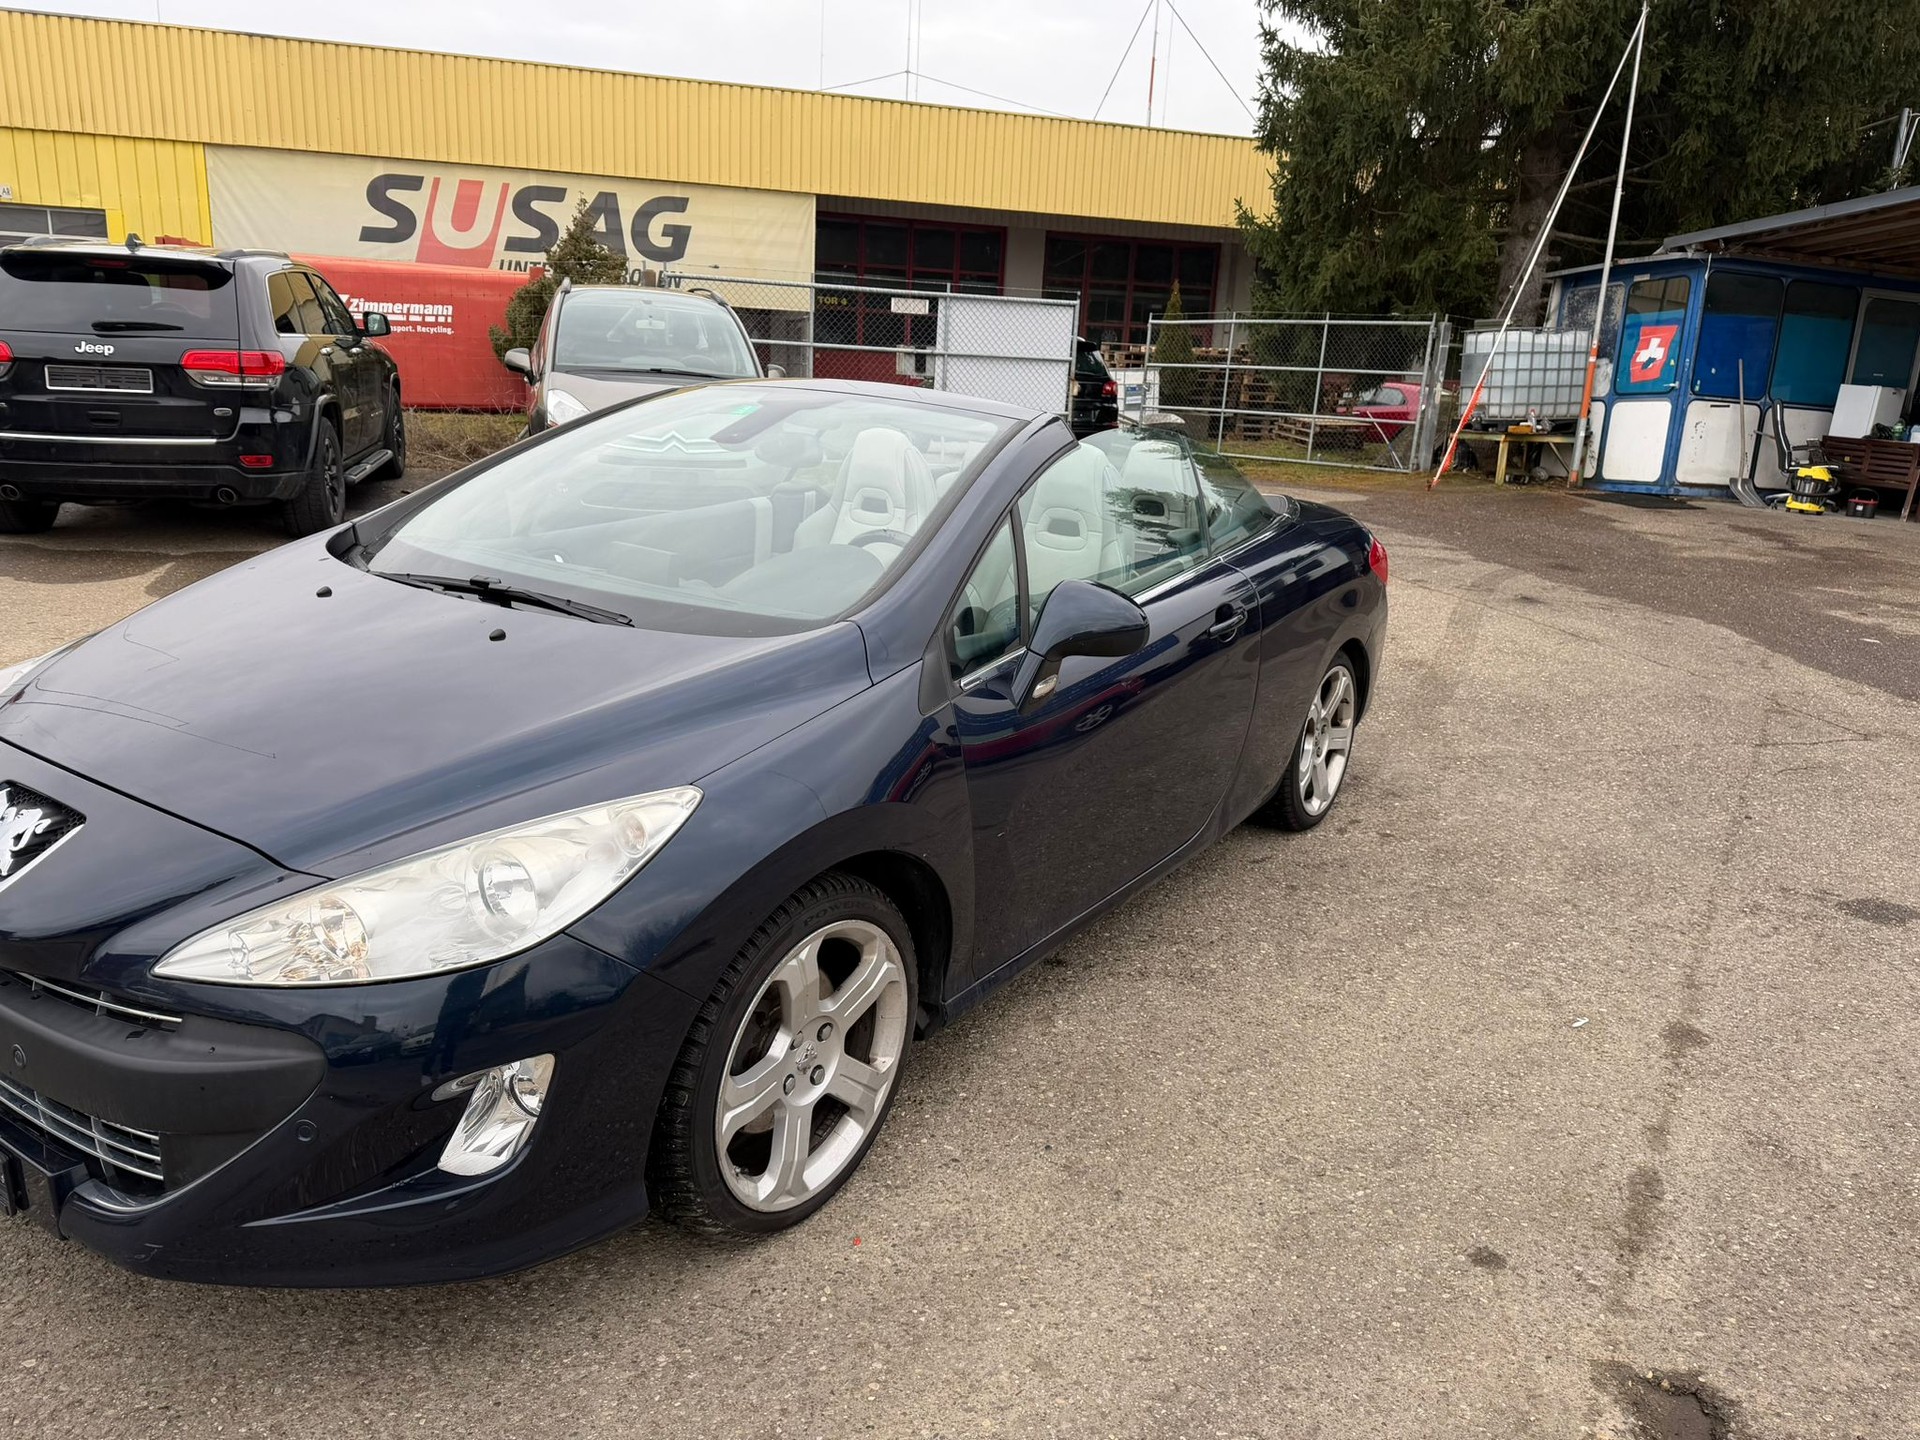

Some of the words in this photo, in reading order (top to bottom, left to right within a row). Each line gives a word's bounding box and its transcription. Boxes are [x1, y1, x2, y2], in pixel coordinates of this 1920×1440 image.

[358, 173, 692, 263] SUSAG
[348, 298, 453, 315] Zimmermann
[818, 296, 838, 305] TOR
[416, 325, 455, 335] Recycling.
[74, 341, 115, 356] Jeep
